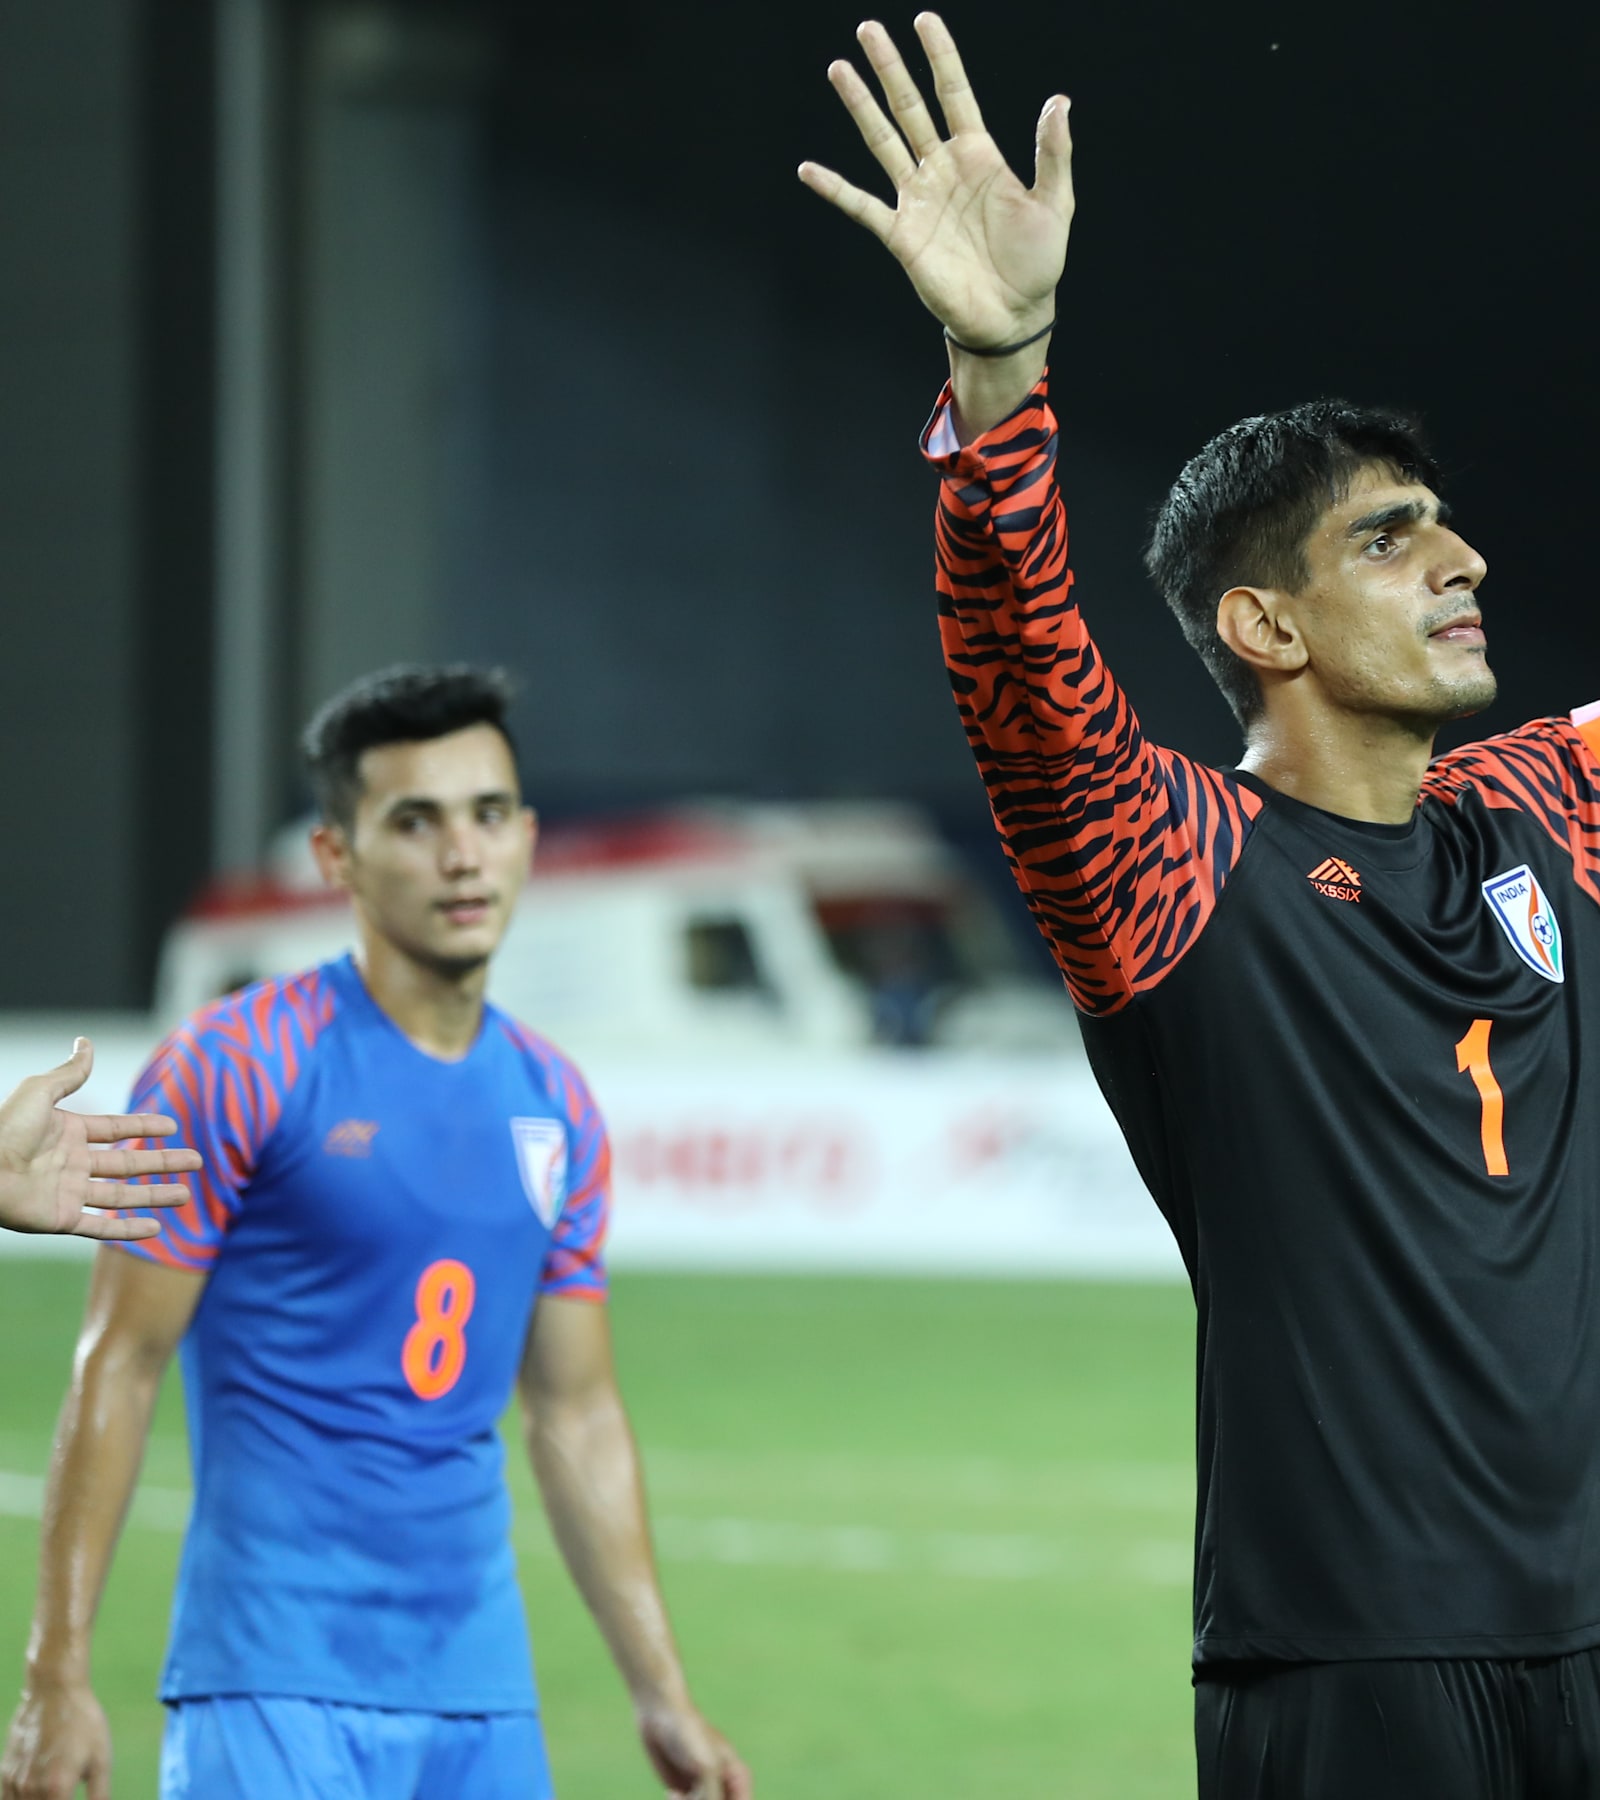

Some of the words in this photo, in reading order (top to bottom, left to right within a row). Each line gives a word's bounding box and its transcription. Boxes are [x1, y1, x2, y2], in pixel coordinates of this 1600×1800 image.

[1496, 882, 1529, 904] INDIA
[1455, 1018, 1511, 1176] 1
[402, 1259, 476, 1401] 8
